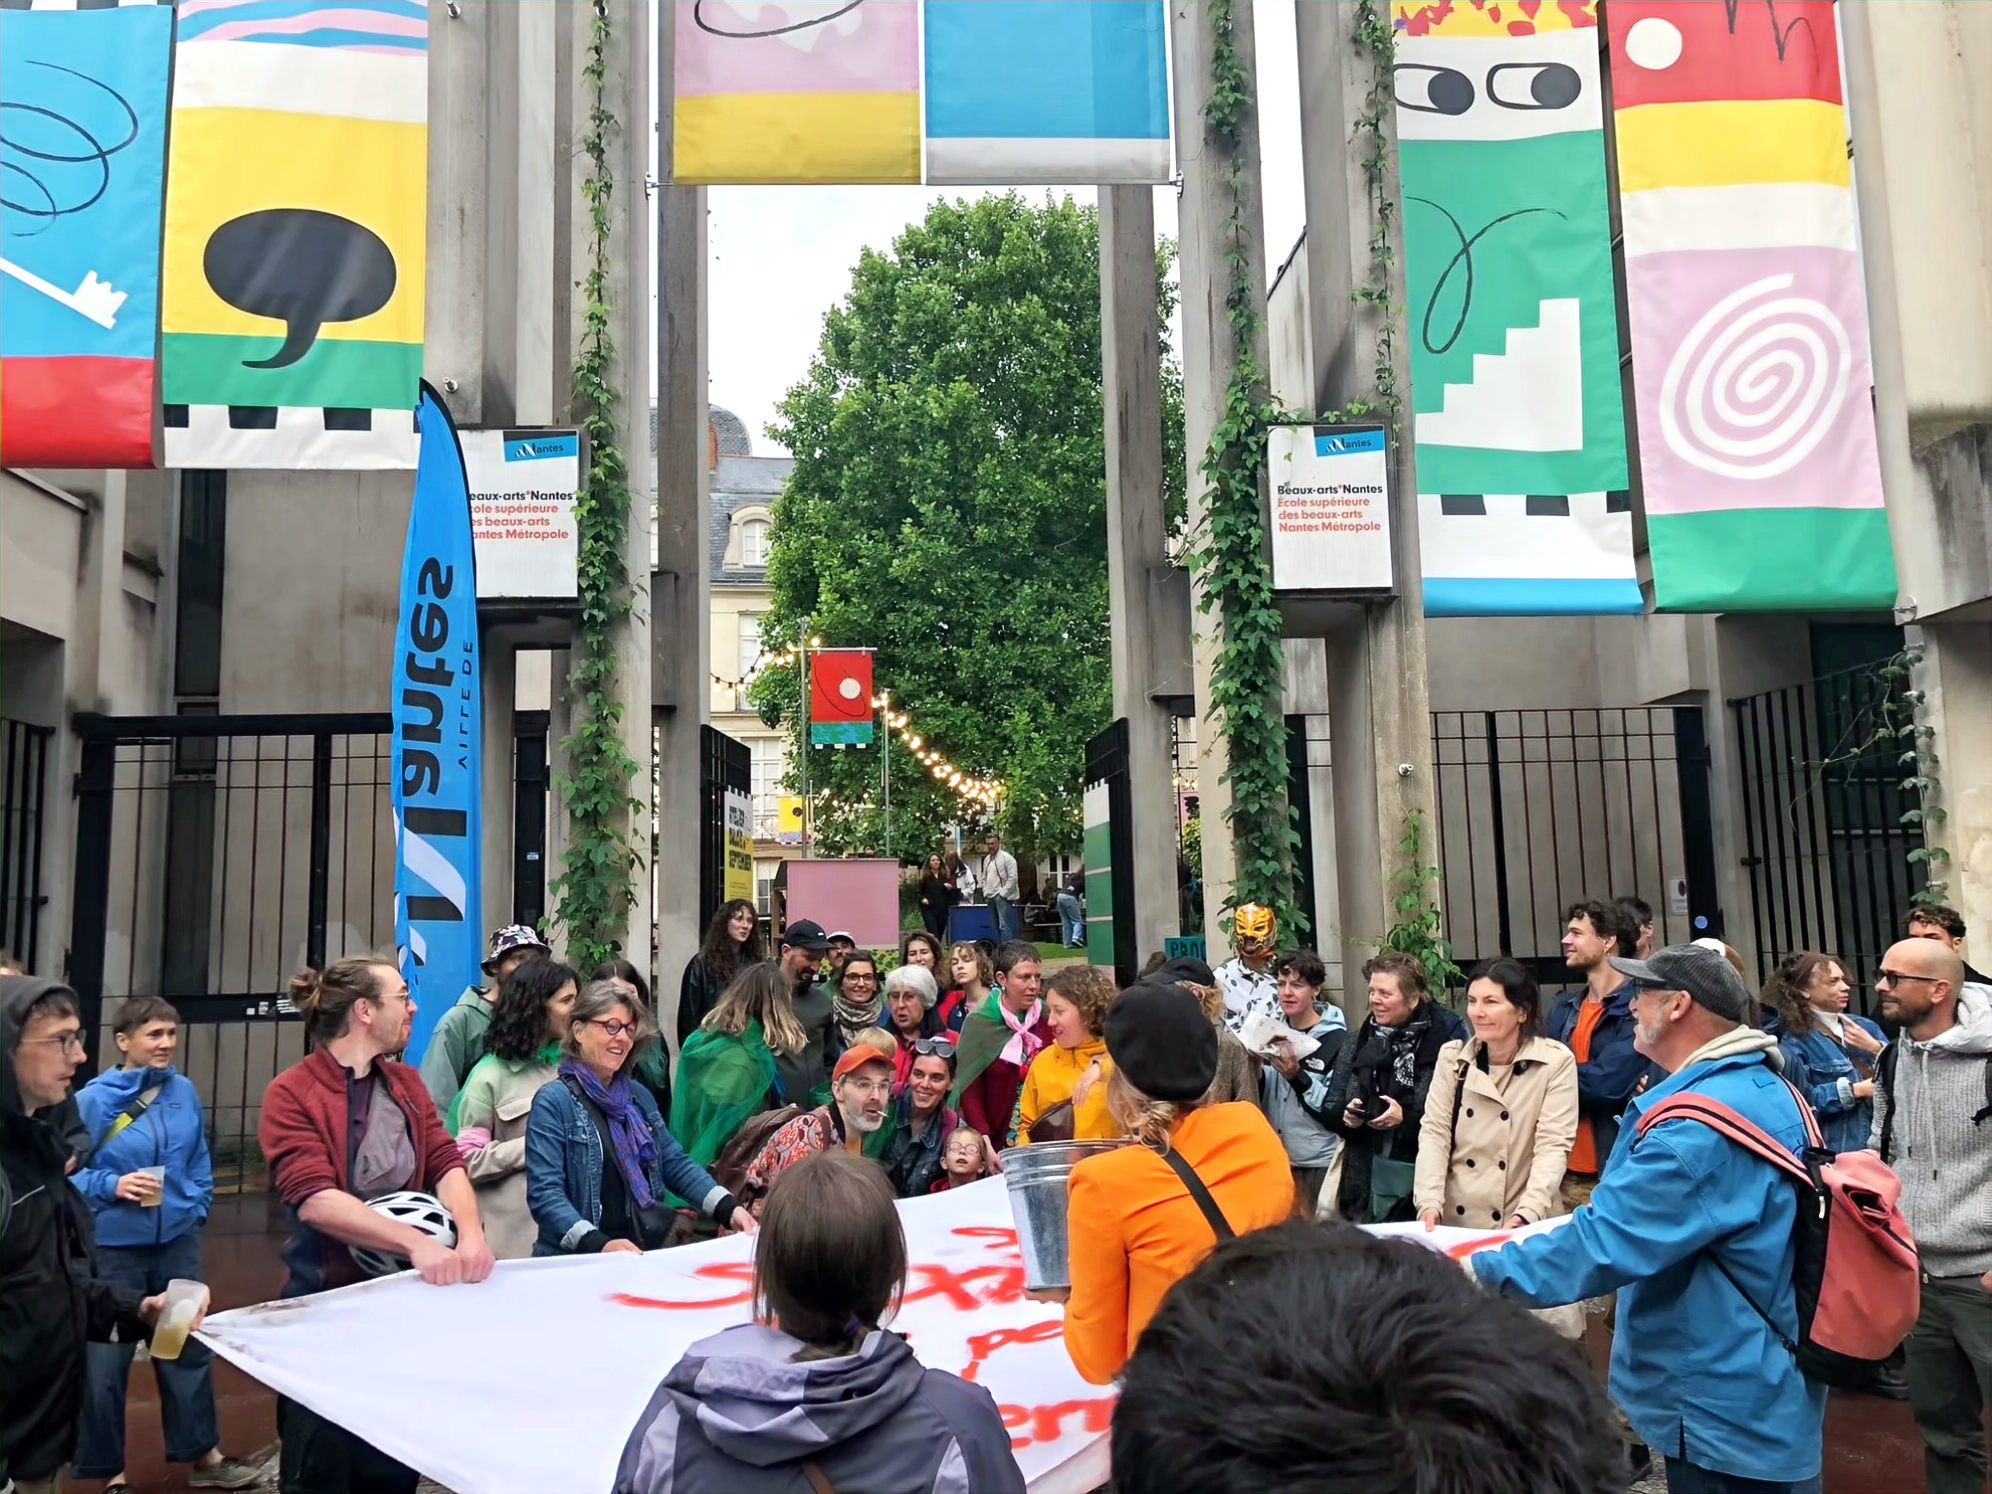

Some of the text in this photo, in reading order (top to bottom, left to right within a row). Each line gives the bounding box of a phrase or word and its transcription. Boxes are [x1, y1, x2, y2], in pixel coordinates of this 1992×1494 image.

[518, 442, 564, 457] Nantes
[1328, 437, 1372, 451] Nantes
[469, 491, 526, 500] eaux-arts
[1309, 497, 1370, 508] supérieure
[471, 503, 559, 516] ole supérieure
[1279, 510, 1363, 520] des beaux-arts
[472, 516, 550, 526] es beaux-arts
[1279, 521, 1381, 533] Nantes Métropole
[473, 528, 569, 541] antes Métropole
